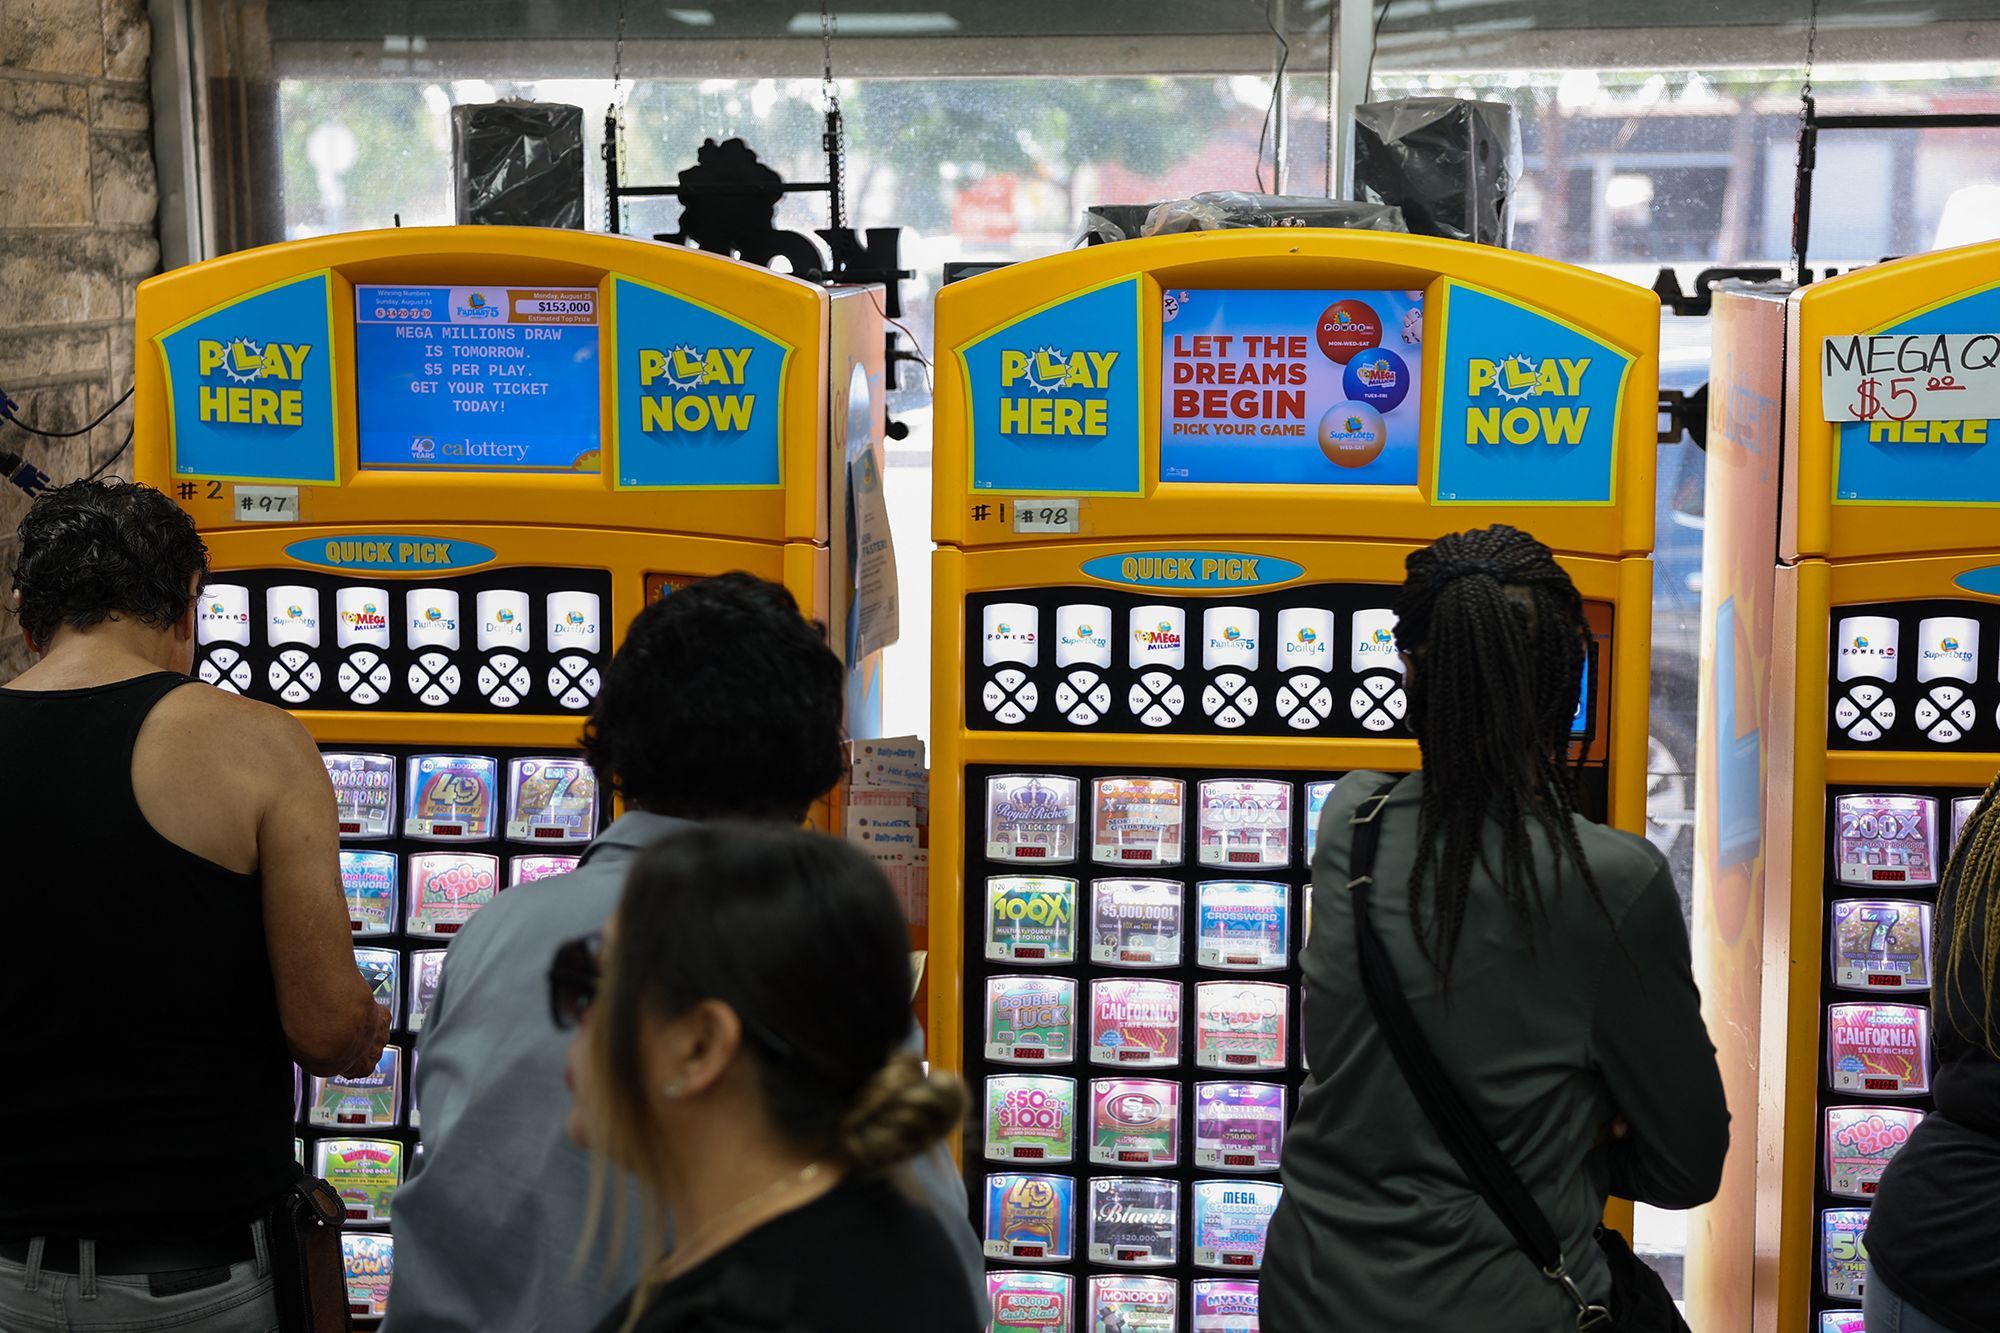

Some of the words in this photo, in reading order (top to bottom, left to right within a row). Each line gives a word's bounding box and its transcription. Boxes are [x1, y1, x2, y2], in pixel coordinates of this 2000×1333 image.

[377, 289, 402, 297] Winning
[403, 289, 430, 297] Numbers
[533, 292, 560, 300] Monday,
[561, 293, 580, 301] August
[457, 307, 489, 318] Fantasy
[538, 301, 590, 313] $153,000
[396, 326, 433, 339] MEGA
[442, 327, 515, 340] MILLIONS
[525, 328, 562, 341] DRAW
[425, 345, 443, 358] IS
[452, 346, 531, 359] TOMORROW.
[1173, 335, 1233, 358] LET
[1243, 336, 1307, 359] THE
[199, 338, 312, 382] PLAY
[1826, 335, 1952, 376] MEGA
[424, 363, 442, 376] $5
[452, 364, 479, 376] PER
[489, 365, 532, 377] PLAY.
[639, 347, 753, 387] PLAY
[1001, 349, 1119, 389] PLAY
[1173, 362, 1307, 385] DREAMS
[1370, 370, 1395, 380] MEGA
[1468, 358, 1592, 397] PLAY
[411, 381, 438, 394] GET
[448, 382, 484, 394] YOUR
[493, 383, 548, 395] TICKET
[199, 386, 302, 426] HERE
[453, 400, 506, 413] TODAY!
[1173, 389, 1306, 419] BEGIN
[640, 395, 755, 432] NOW
[1000, 397, 1107, 436] HERE
[1173, 423, 1209, 436] PICK
[1213, 424, 1256, 436] YOUR
[1260, 424, 1306, 437] GAME
[1466, 406, 1591, 444] NOW
[1869, 419, 1988, 443] HERE
[1329, 430, 1375, 441] SuperLotto
[411, 451, 435, 460] YEARS
[441, 438, 530, 461] calottery
[206, 480, 224, 500] 2
[259, 496, 287, 512] 97
[1040, 508, 1069, 525] 98
[326, 541, 393, 563] QUICK
[399, 543, 451, 563] PICK
[1122, 557, 1195, 581] QUICK
[1202, 558, 1259, 581] PICK
[356, 613, 385, 625] MEGA
[447, 620, 456, 631] 5
[515, 623, 523, 633] 4
[587, 624, 595, 634] 3
[1150, 631, 1180, 644] MEGA
[1246, 639, 1255, 650] 5
[1286, 642, 1315, 655] Daily
[1317, 642, 1325, 653] 4
[1359, 641, 1392, 655] Daily
[1862, 693, 1872, 701] $2
[430, 772, 481, 806] 40
[544, 766, 579, 807] 7
[995, 802, 1032, 821] Royal
[1207, 798, 1282, 824] 200X
[1842, 814, 1923, 839] 200X
[994, 893, 1067, 927] 100X
[1102, 905, 1175, 921] $5,000,000!
[1207, 911, 1278, 921] CROSSWORD
[1860, 907, 1900, 952] 7
[999, 992, 1058, 1010] DOUBLE
[1011, 1006, 1068, 1029] LUCK
[1883, 1047, 1914, 1055] RICHES
[1006, 1089, 1047, 1110] $50
[999, 1108, 1062, 1129] $100!
[1838, 1115, 1886, 1146] $100
[1858, 1125, 1909, 1154] $200
[1206, 1153, 1216, 1162] 15
[1839, 1179, 1849, 1187] 13
[1008, 1177, 1054, 1209] 40
[1223, 1191, 1255, 1204] MEGA
[1100, 1248, 1109, 1256] 18
[1835, 1282, 1845, 1290] 17
[1102, 1291, 1168, 1304] MONOPOLY
[1000, 1309, 1026, 1320] Cash
[1028, 1307, 1059, 1320] Blast
